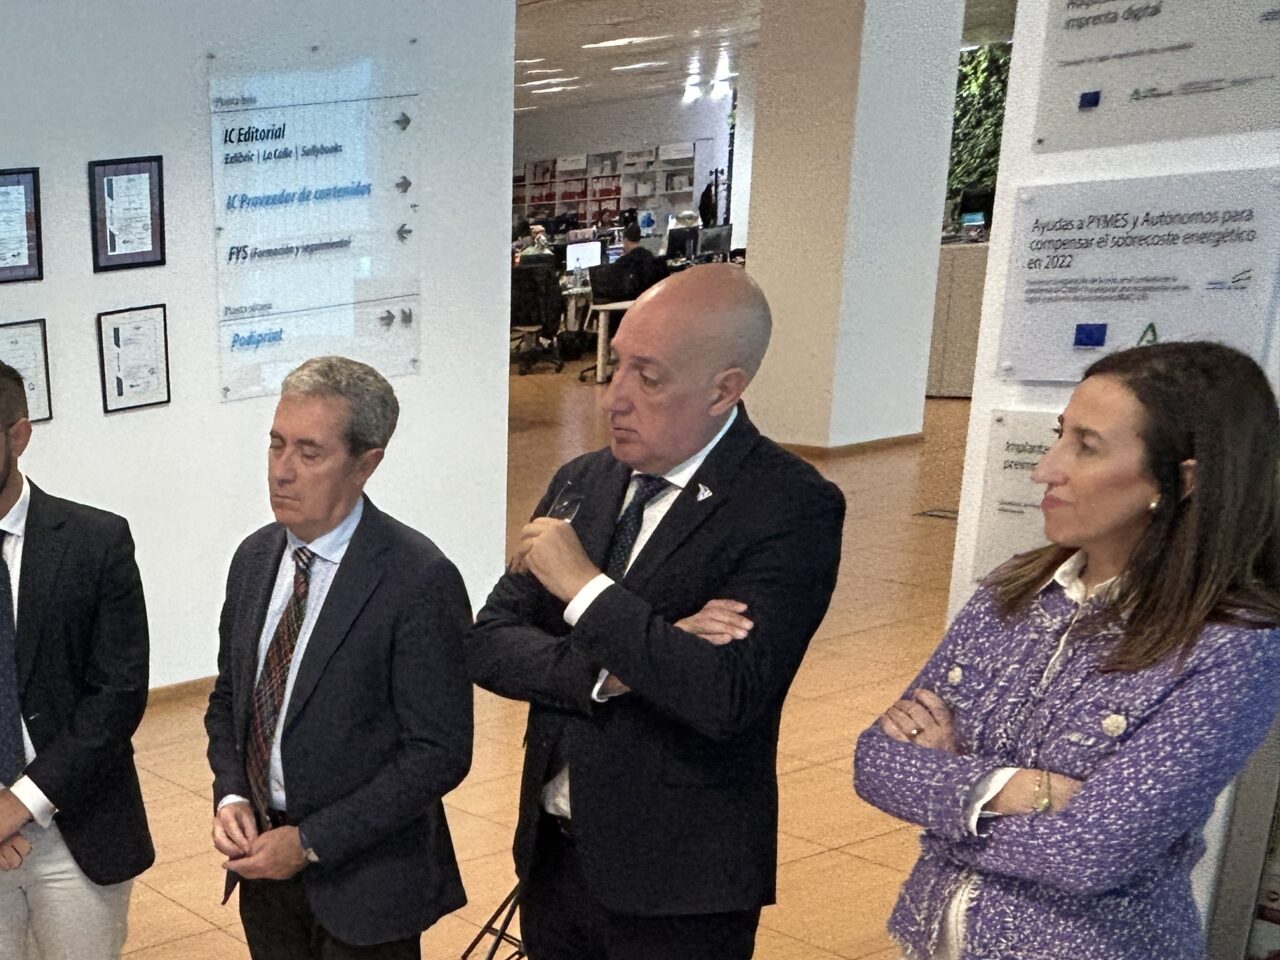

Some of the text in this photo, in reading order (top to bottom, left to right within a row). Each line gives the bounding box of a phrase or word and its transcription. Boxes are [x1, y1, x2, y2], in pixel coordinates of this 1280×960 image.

[224, 122, 287, 144] IC Editorial
[298, 187, 312, 202] de
[1031, 218, 1074, 236] Ayudas
[1077, 219, 1084, 230] a
[1087, 213, 1129, 229] PYMES
[1125, 215, 1139, 234] y
[1027, 254, 1073, 270] en 2022
